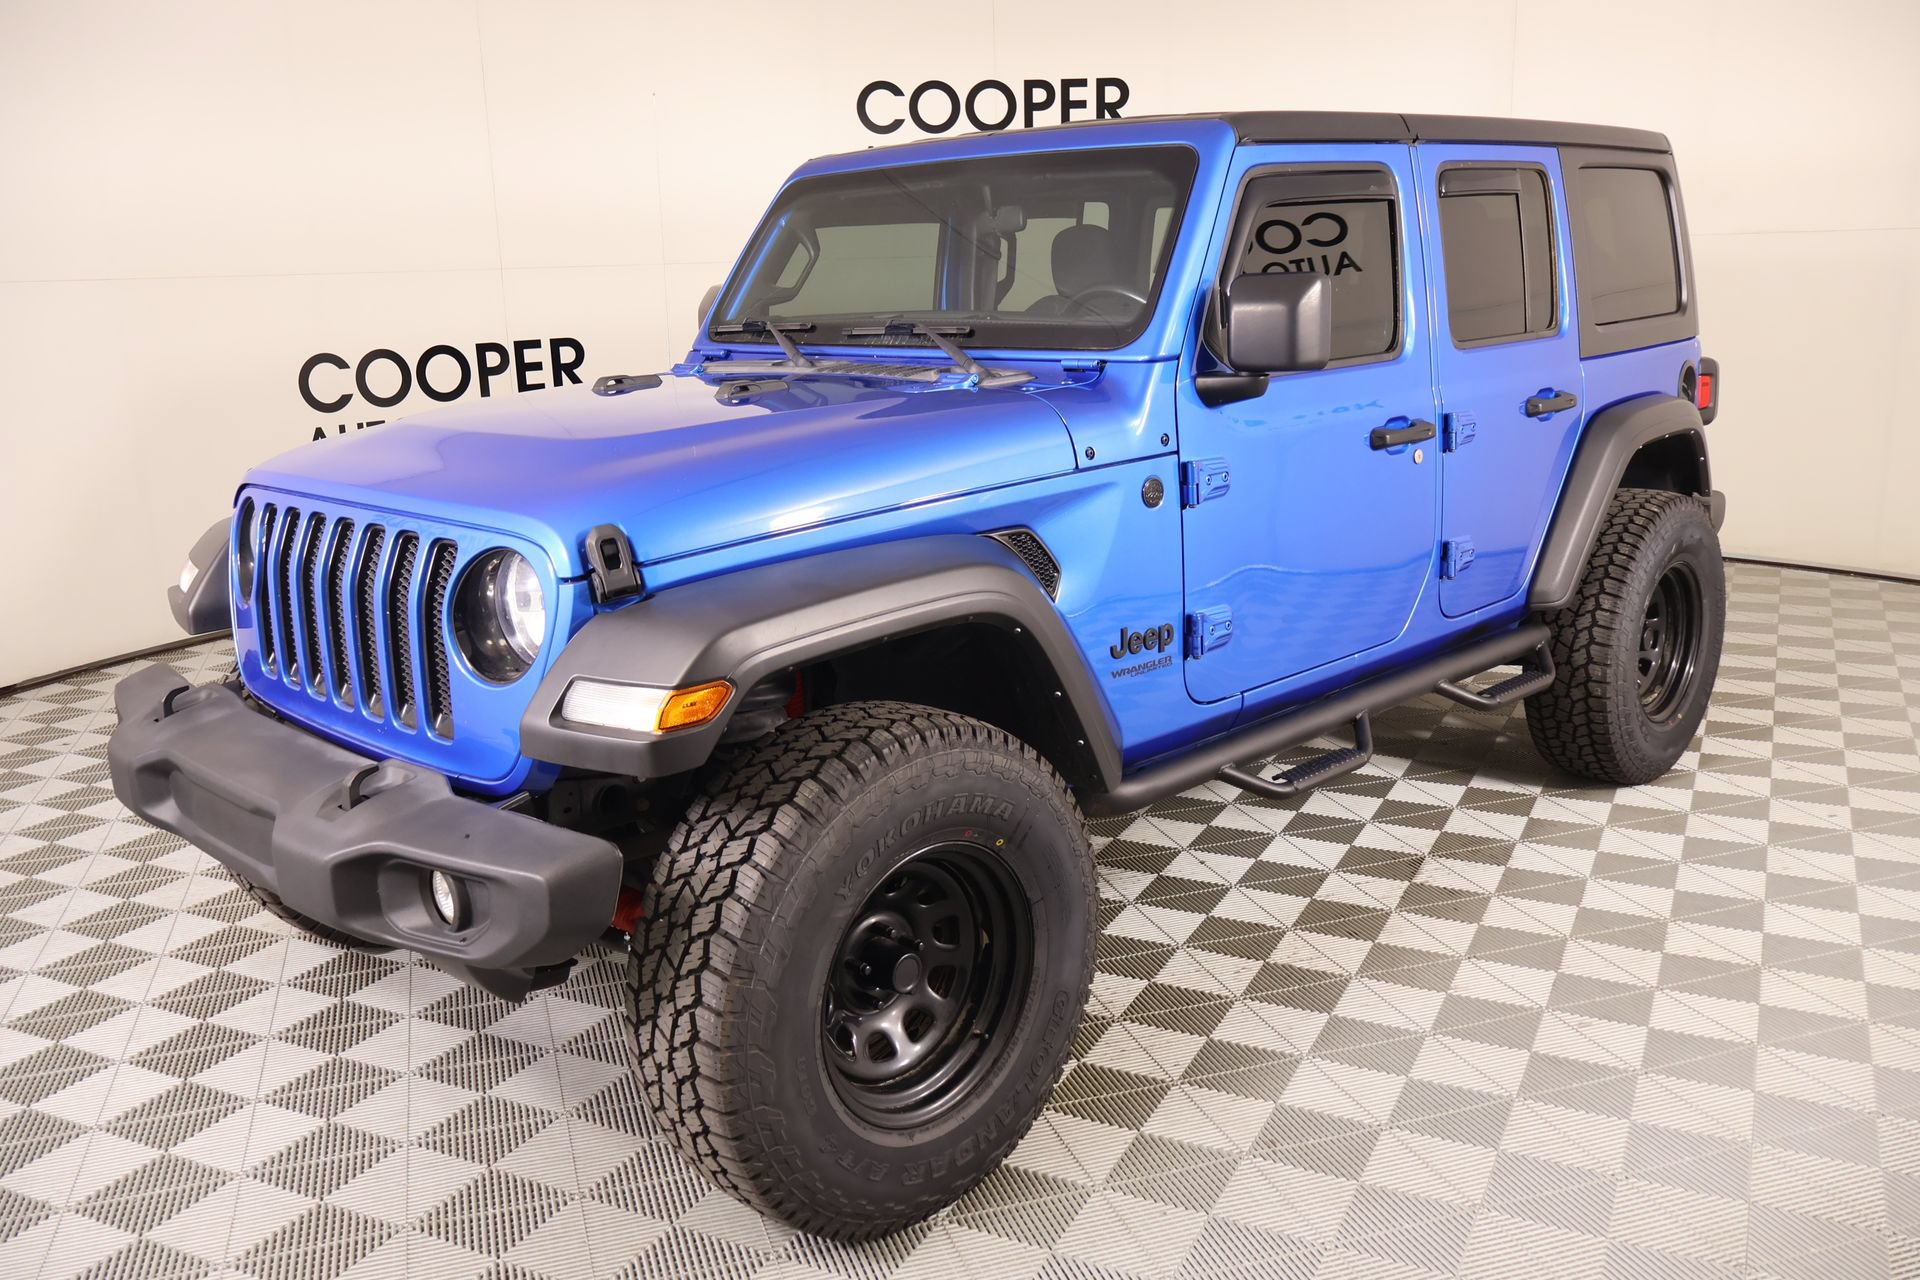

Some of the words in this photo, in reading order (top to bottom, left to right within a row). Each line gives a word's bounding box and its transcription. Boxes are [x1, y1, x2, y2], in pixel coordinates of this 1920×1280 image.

[856, 77, 1130, 134] COOPER
[298, 337, 585, 413] COOPER
[1110, 623, 1174, 659] Jeep
[1111, 655, 1172, 679] WRANGLER
[835, 792, 1015, 900] YOKOHAMA
